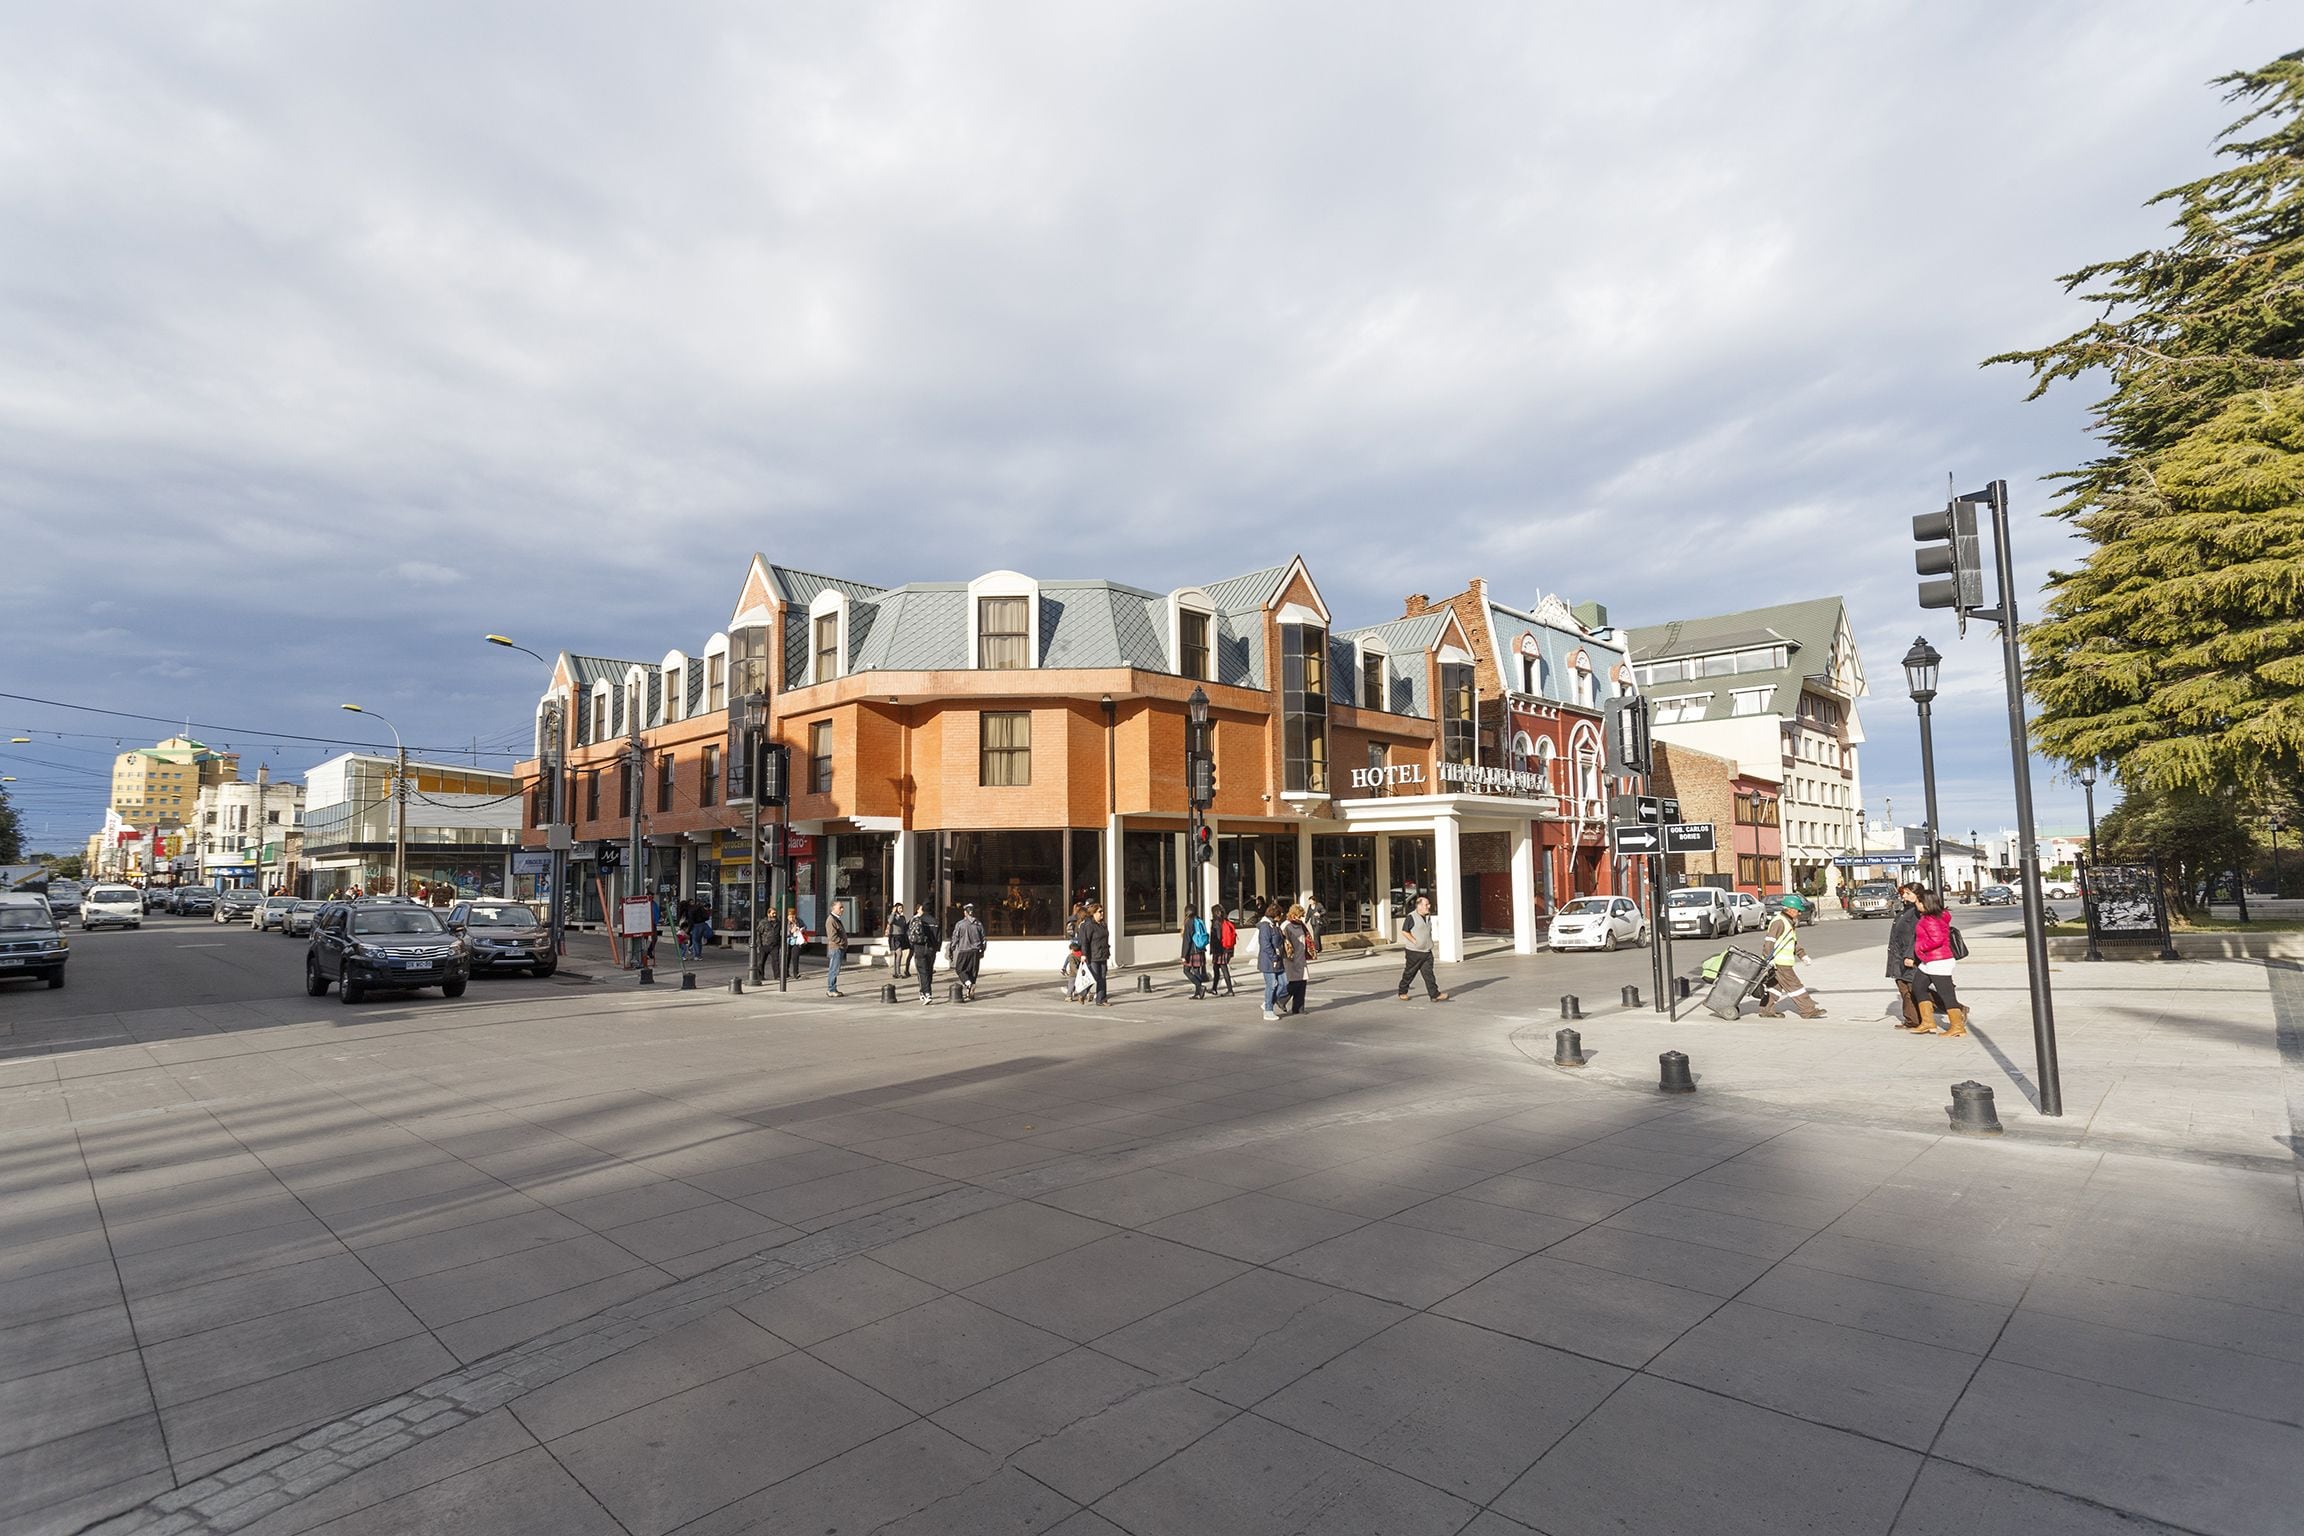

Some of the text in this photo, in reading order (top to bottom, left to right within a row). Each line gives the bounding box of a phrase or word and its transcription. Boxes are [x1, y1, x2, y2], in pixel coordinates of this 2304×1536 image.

[1351, 764, 1427, 788] HOTEL
[1685, 825, 1709, 833] CARLOS
[720, 841, 753, 849] FOTOCENTR
[787, 836, 804, 848] laro
